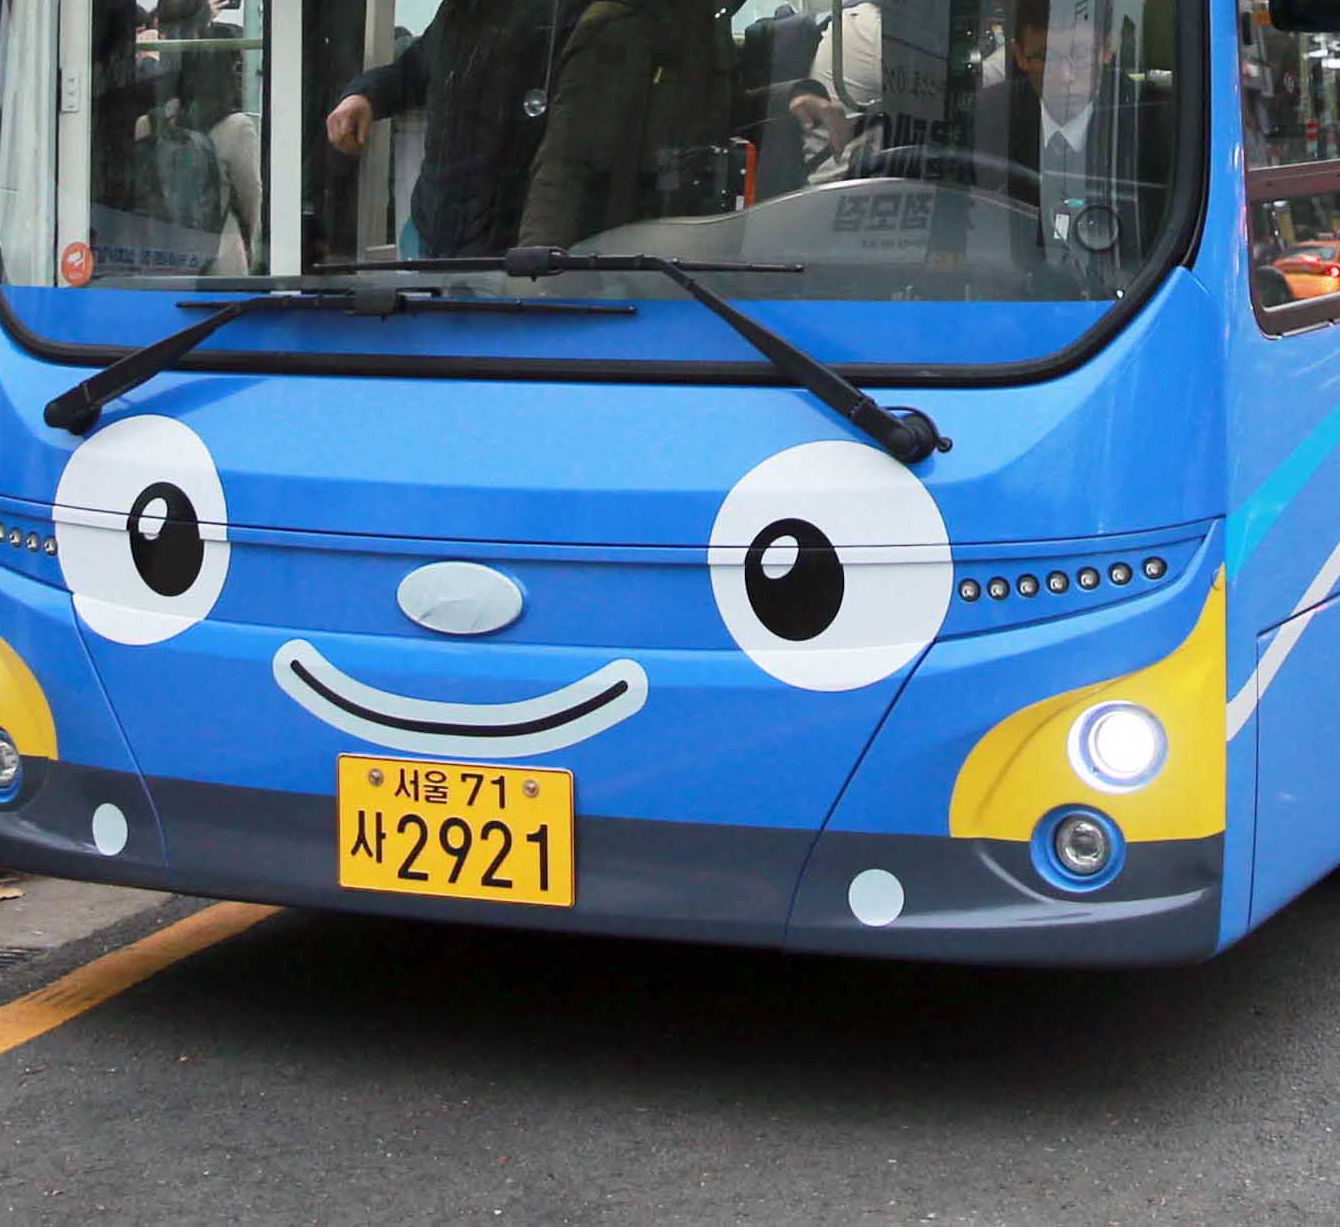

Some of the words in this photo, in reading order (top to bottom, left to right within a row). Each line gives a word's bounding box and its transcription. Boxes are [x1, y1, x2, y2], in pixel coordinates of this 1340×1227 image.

[395, 768, 449, 804] 서울
[460, 773, 506, 809] 71
[350, 809, 549, 892] 사2921
